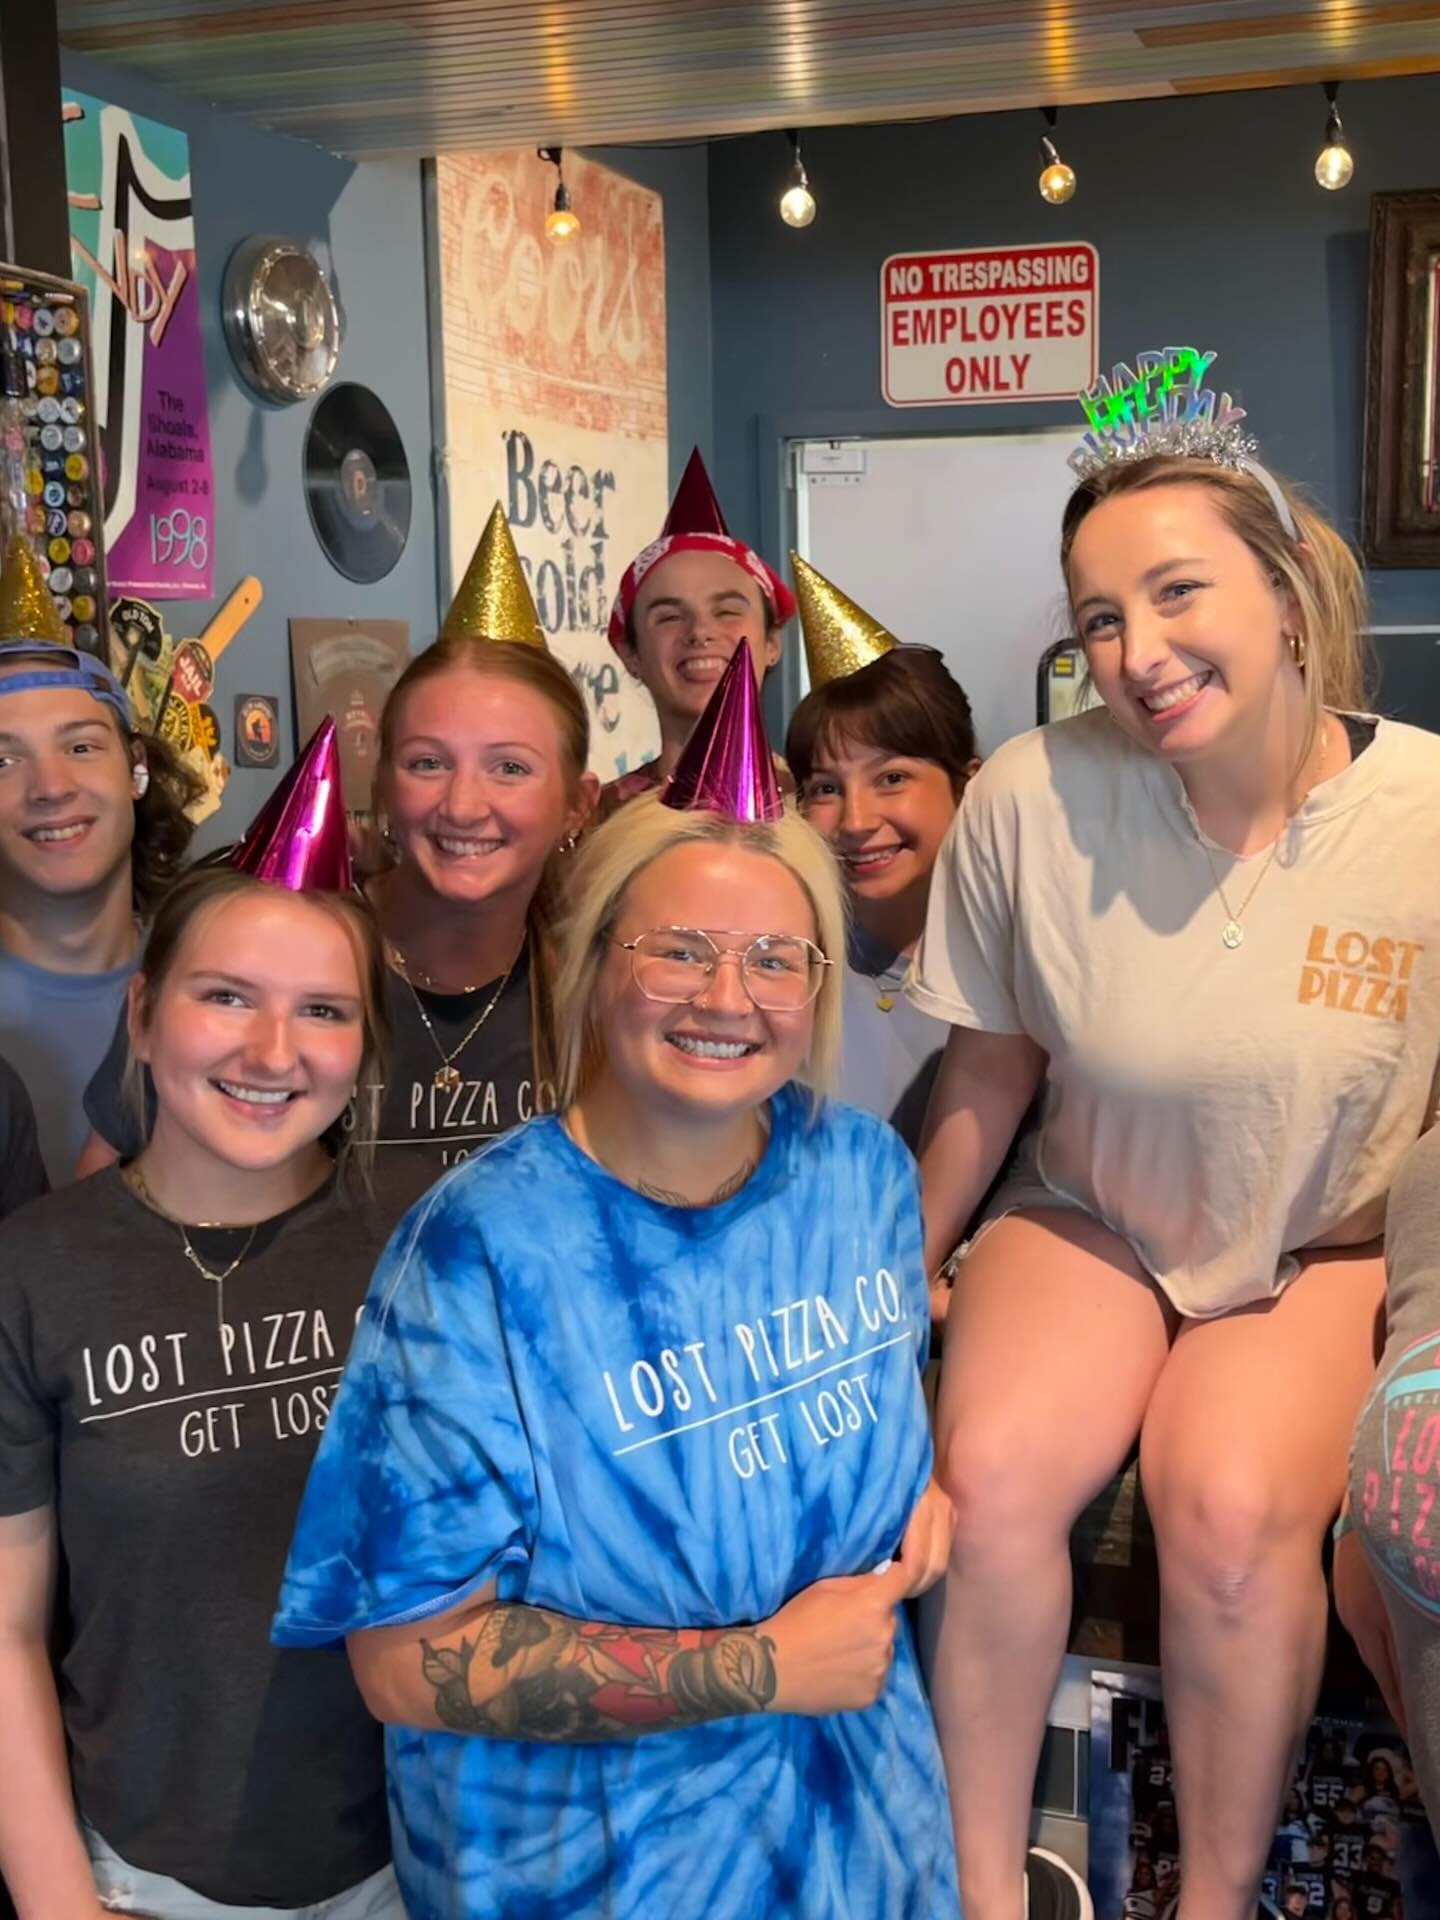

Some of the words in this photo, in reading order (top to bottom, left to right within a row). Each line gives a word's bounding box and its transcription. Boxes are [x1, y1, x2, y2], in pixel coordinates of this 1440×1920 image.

[890, 265, 923, 295] NO
[929, 254, 1089, 292] TRESPASSING
[892, 299, 1087, 347] EMPLOYEES
[945, 353, 1031, 394] ONLY
[1079, 346, 1218, 432] HAPPY
[158, 390, 184, 413] The
[146, 438, 205, 462] Alabama
[146, 474, 189, 497] August
[501, 429, 616, 539] Beer
[150, 508, 208, 570] 1998
[1306, 924, 1424, 978] LOST
[1297, 965, 1409, 1022] PIZZA
[341, 1084, 384, 1131] ST
[411, 1081, 498, 1130] PIZZA
[83, 1332, 188, 1406] LOST
[219, 1308, 335, 1376] PIZZA
[603, 1342, 717, 1433] LOST
[735, 1295, 848, 1383] PIZZA
[855, 1268, 907, 1332] CO.
[180, 1403, 245, 1457] GET
[728, 1412, 788, 1479] GET
[800, 1373, 878, 1446] LOST
[1391, 1407, 1440, 1475] LO
[1363, 1469, 1436, 1549] PIZ
